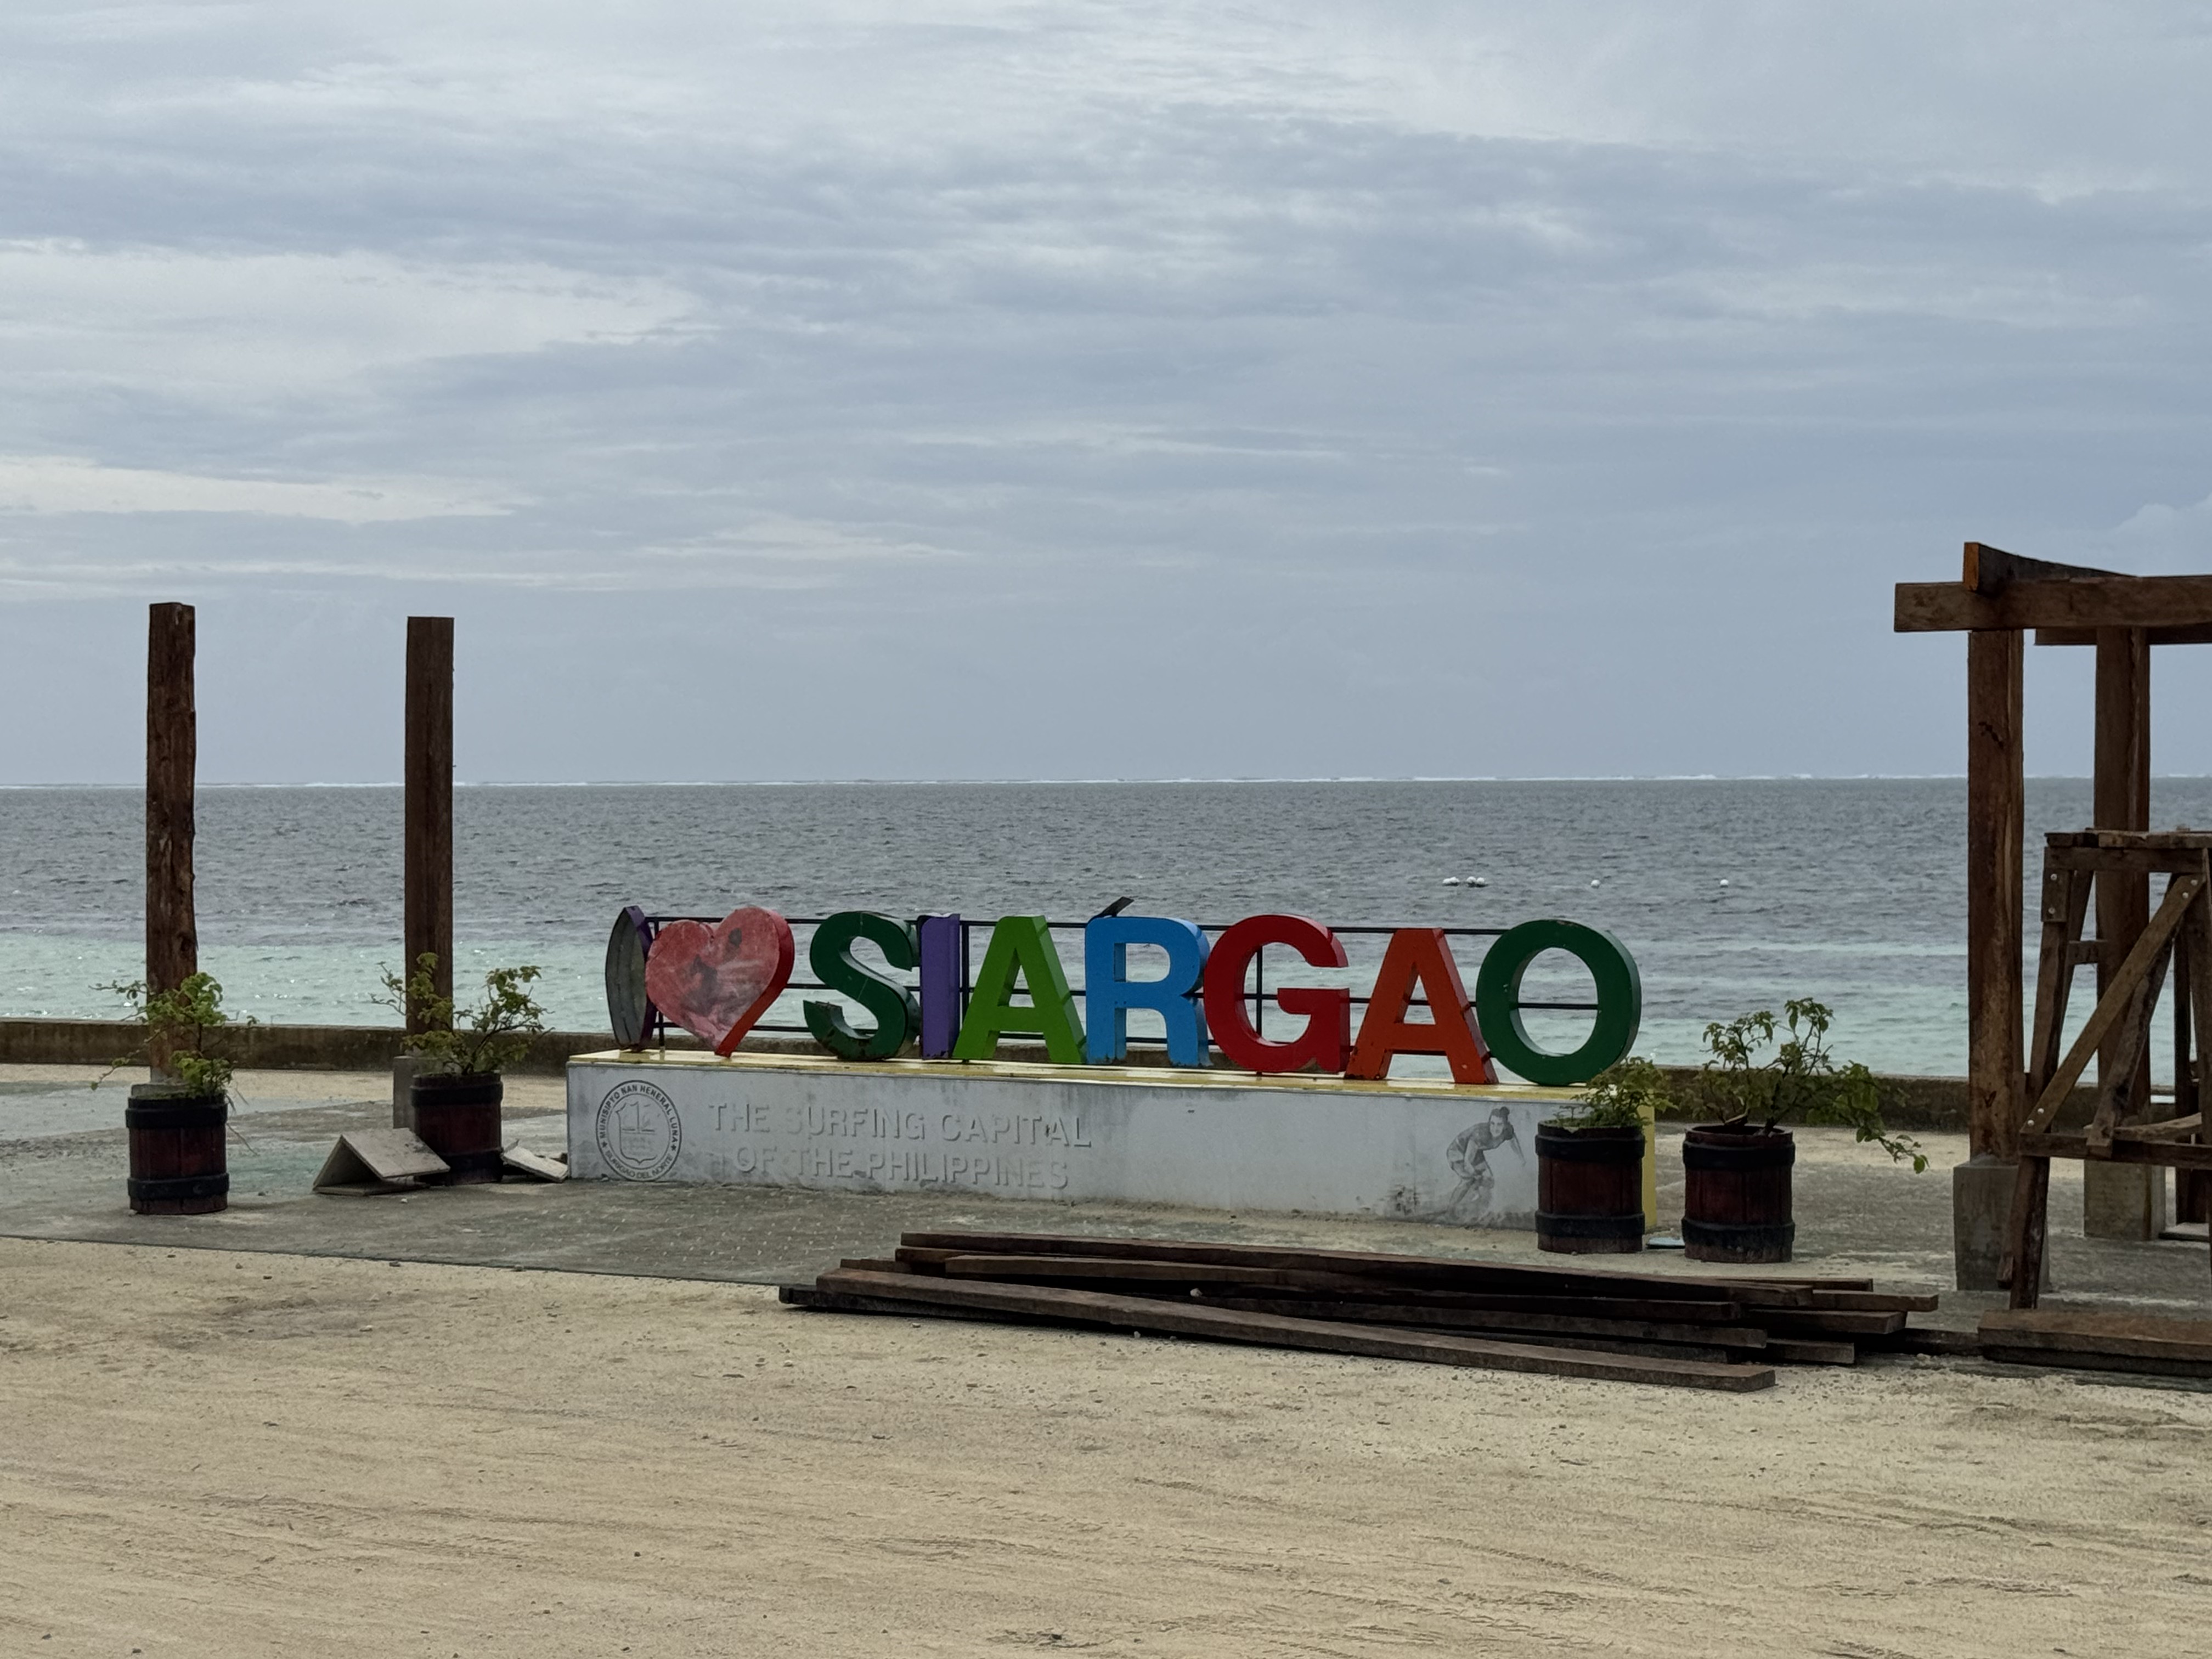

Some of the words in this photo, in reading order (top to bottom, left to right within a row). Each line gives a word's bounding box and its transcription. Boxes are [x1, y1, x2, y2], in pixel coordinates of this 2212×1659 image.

[804, 908, 1641, 1086] SIARGAO
[600, 1092, 620, 1138] MUNISIPYO
[621, 1084, 637, 1094] NAN
[640, 1085, 671, 1115] HENERAL
[669, 1116, 679, 1143] LUNA
[709, 1102, 771, 1133] THE
[785, 1105, 926, 1141] SURFING
[941, 1113, 1093, 1149] CAPITAL
[636, 1171, 652, 1179] DEL
[652, 1153, 673, 1176] NORTE
[734, 1144, 778, 1177] OF
[791, 1147, 854, 1180] THE
[867, 1150, 1070, 1190] PHILIPPINES
